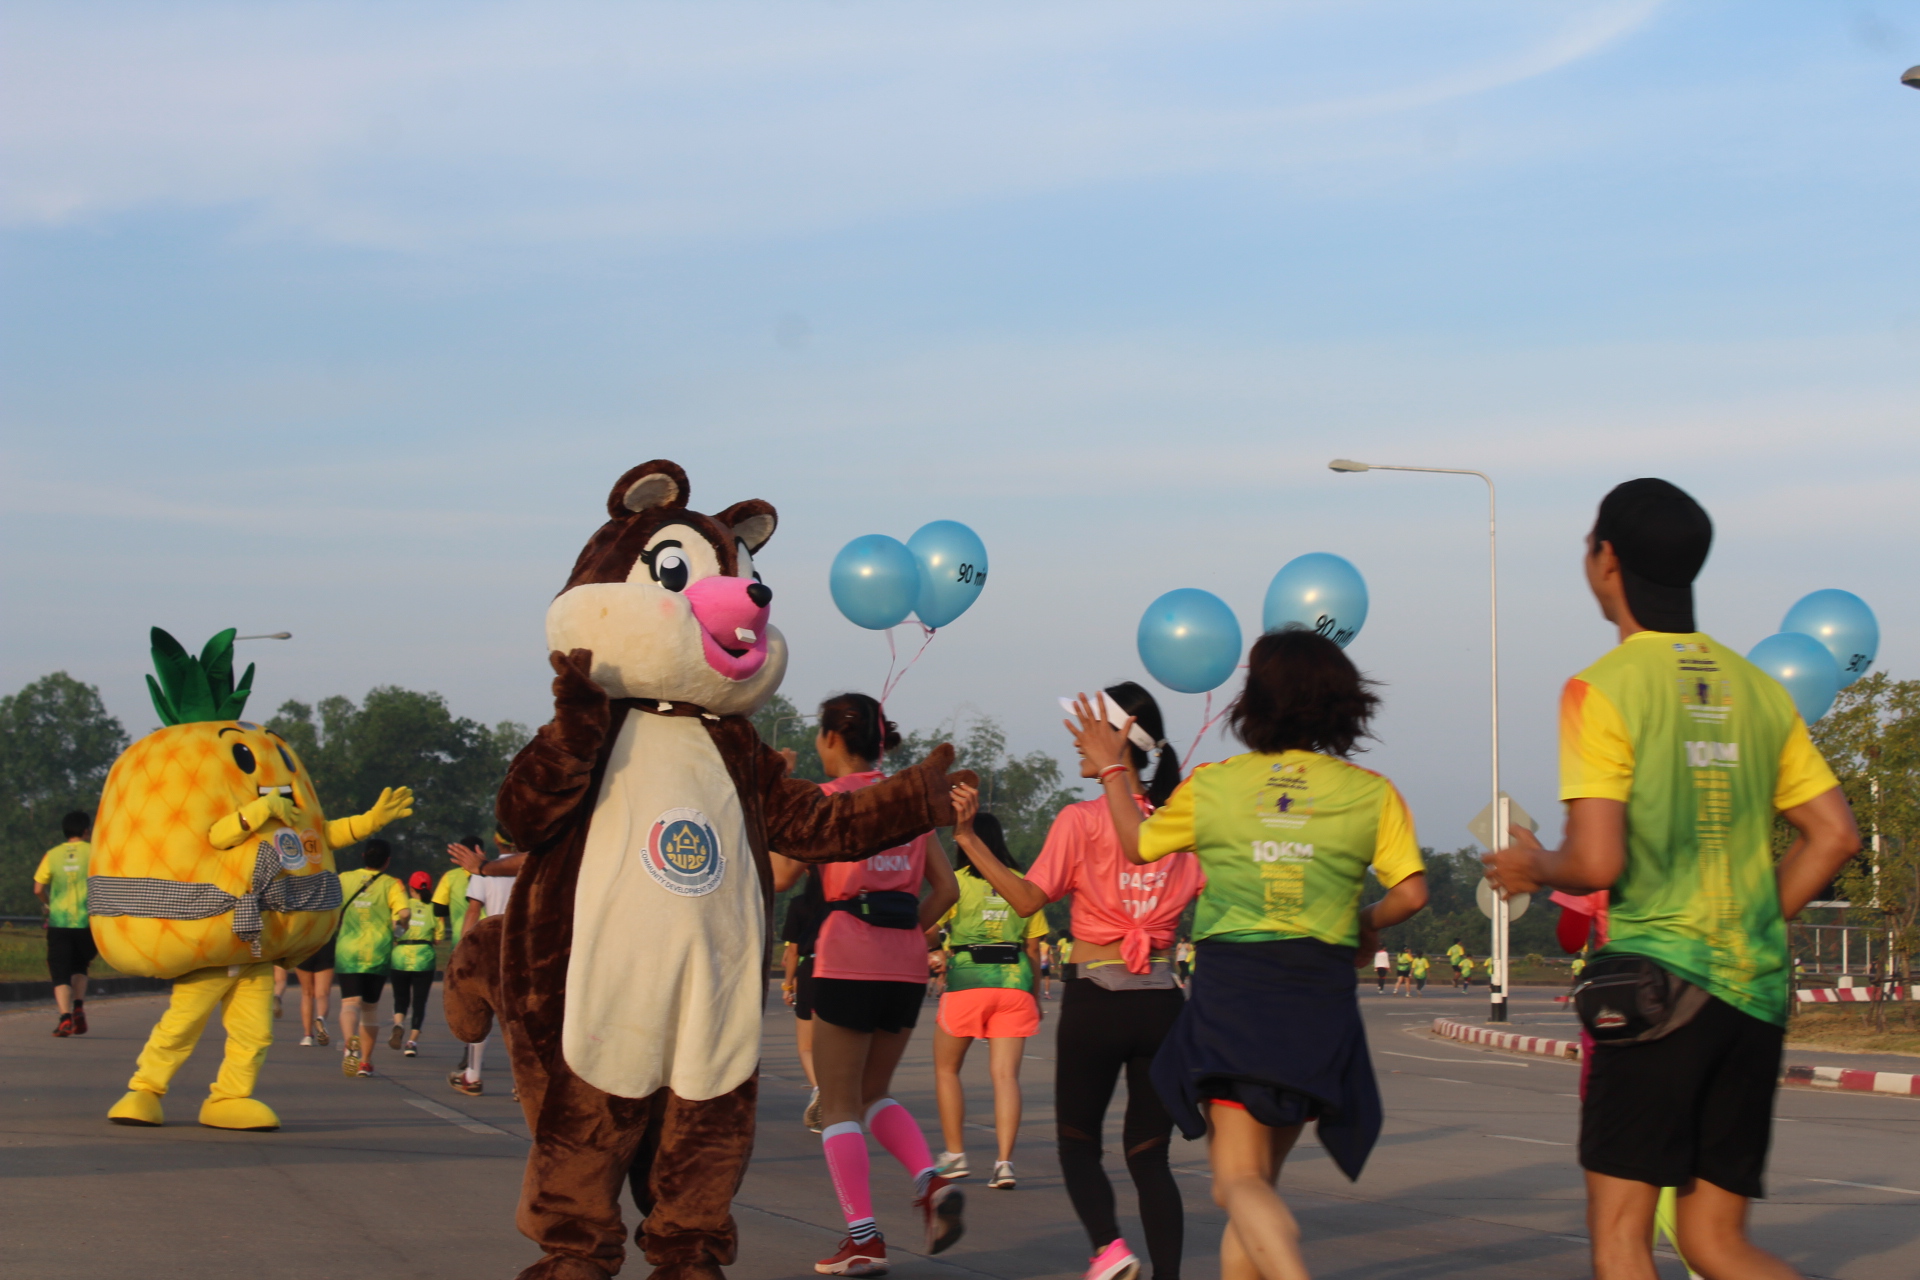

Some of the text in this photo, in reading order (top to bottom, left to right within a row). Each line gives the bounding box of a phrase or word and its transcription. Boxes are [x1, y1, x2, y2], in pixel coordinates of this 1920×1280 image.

[957, 563, 973, 583] 90
[1315, 614, 1336, 638] 90
[1251, 840, 1314, 863] 10KM
[640, 849, 667, 884] COMMUNITY
[664, 880, 708, 895] DEVELOPMENT
[1119, 872, 1168, 891] PACR
